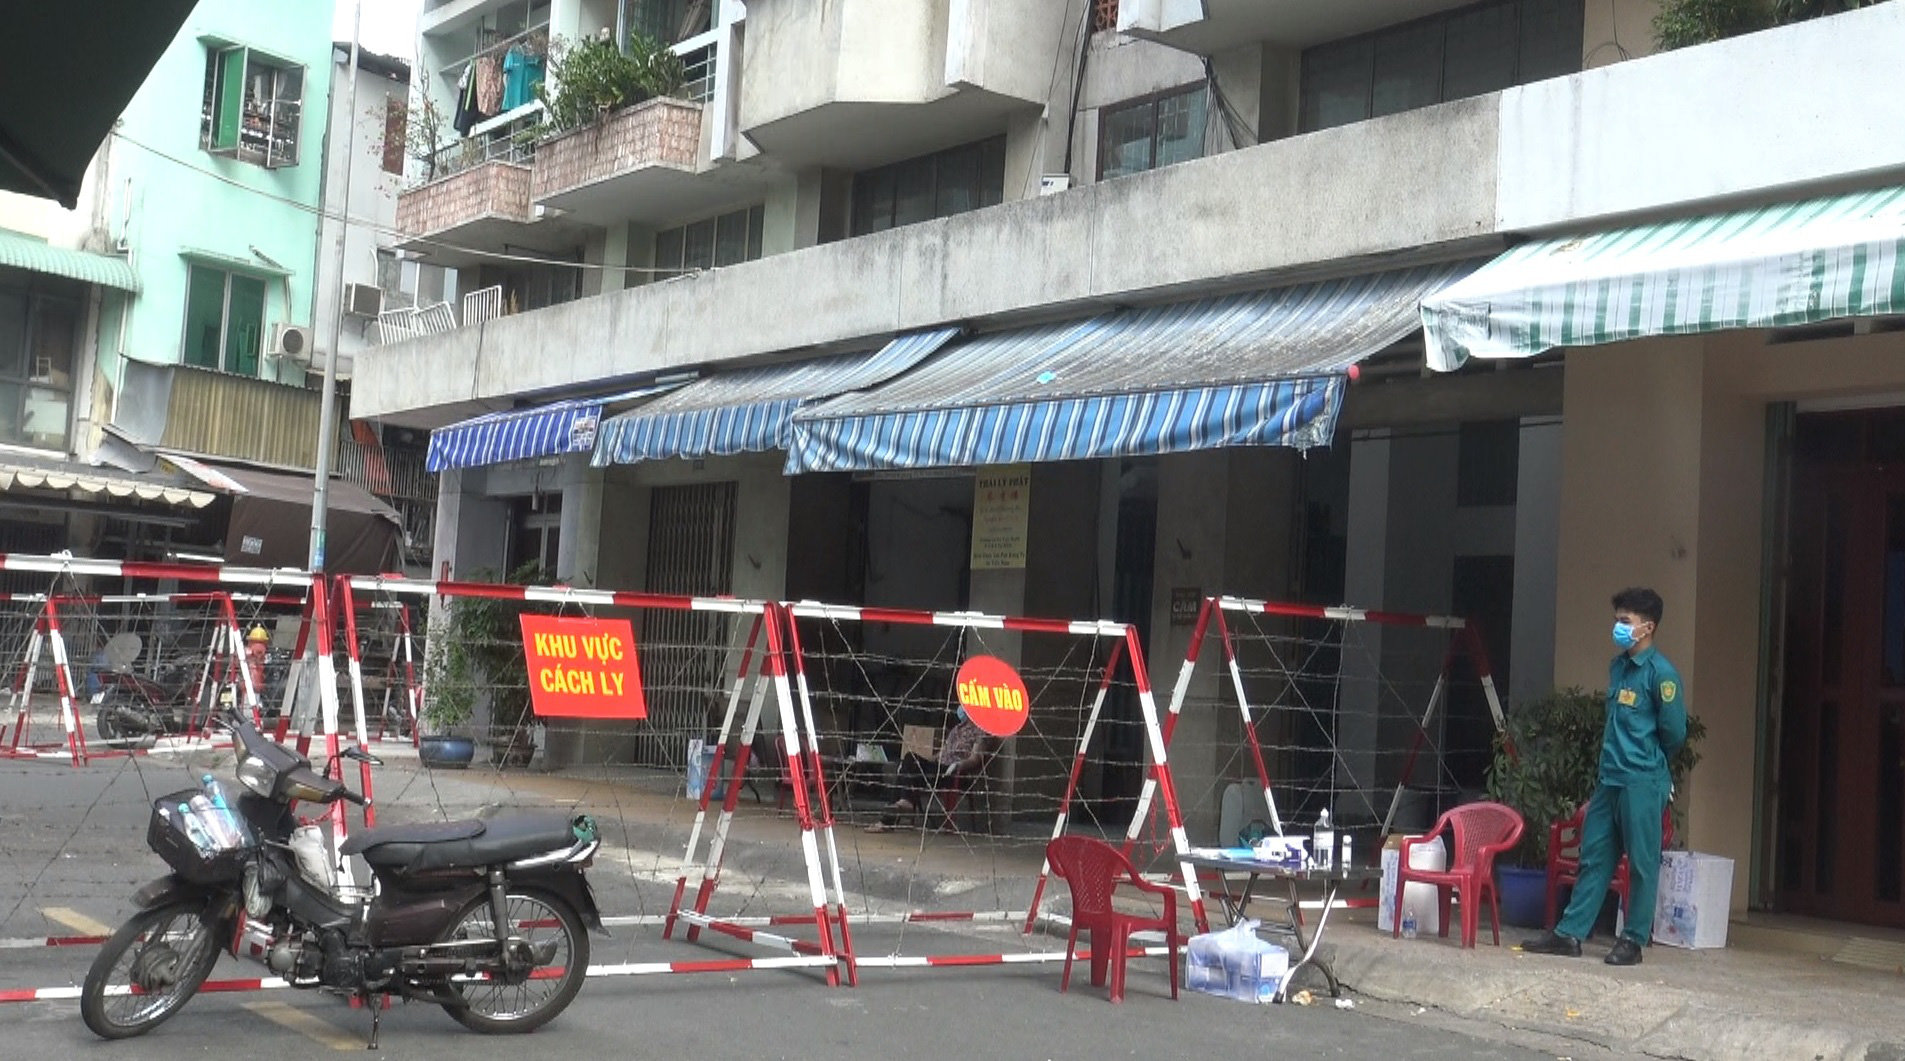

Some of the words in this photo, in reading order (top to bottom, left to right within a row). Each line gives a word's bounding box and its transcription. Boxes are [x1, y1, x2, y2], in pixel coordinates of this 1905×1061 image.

[535, 632, 577, 659] KHU
[581, 632, 623, 666] VỰC
[540, 663, 595, 694] CÁCH
[600, 671, 624, 696] LY
[959, 678, 992, 709] CẤM
[993, 683, 1023, 712] VÀO
